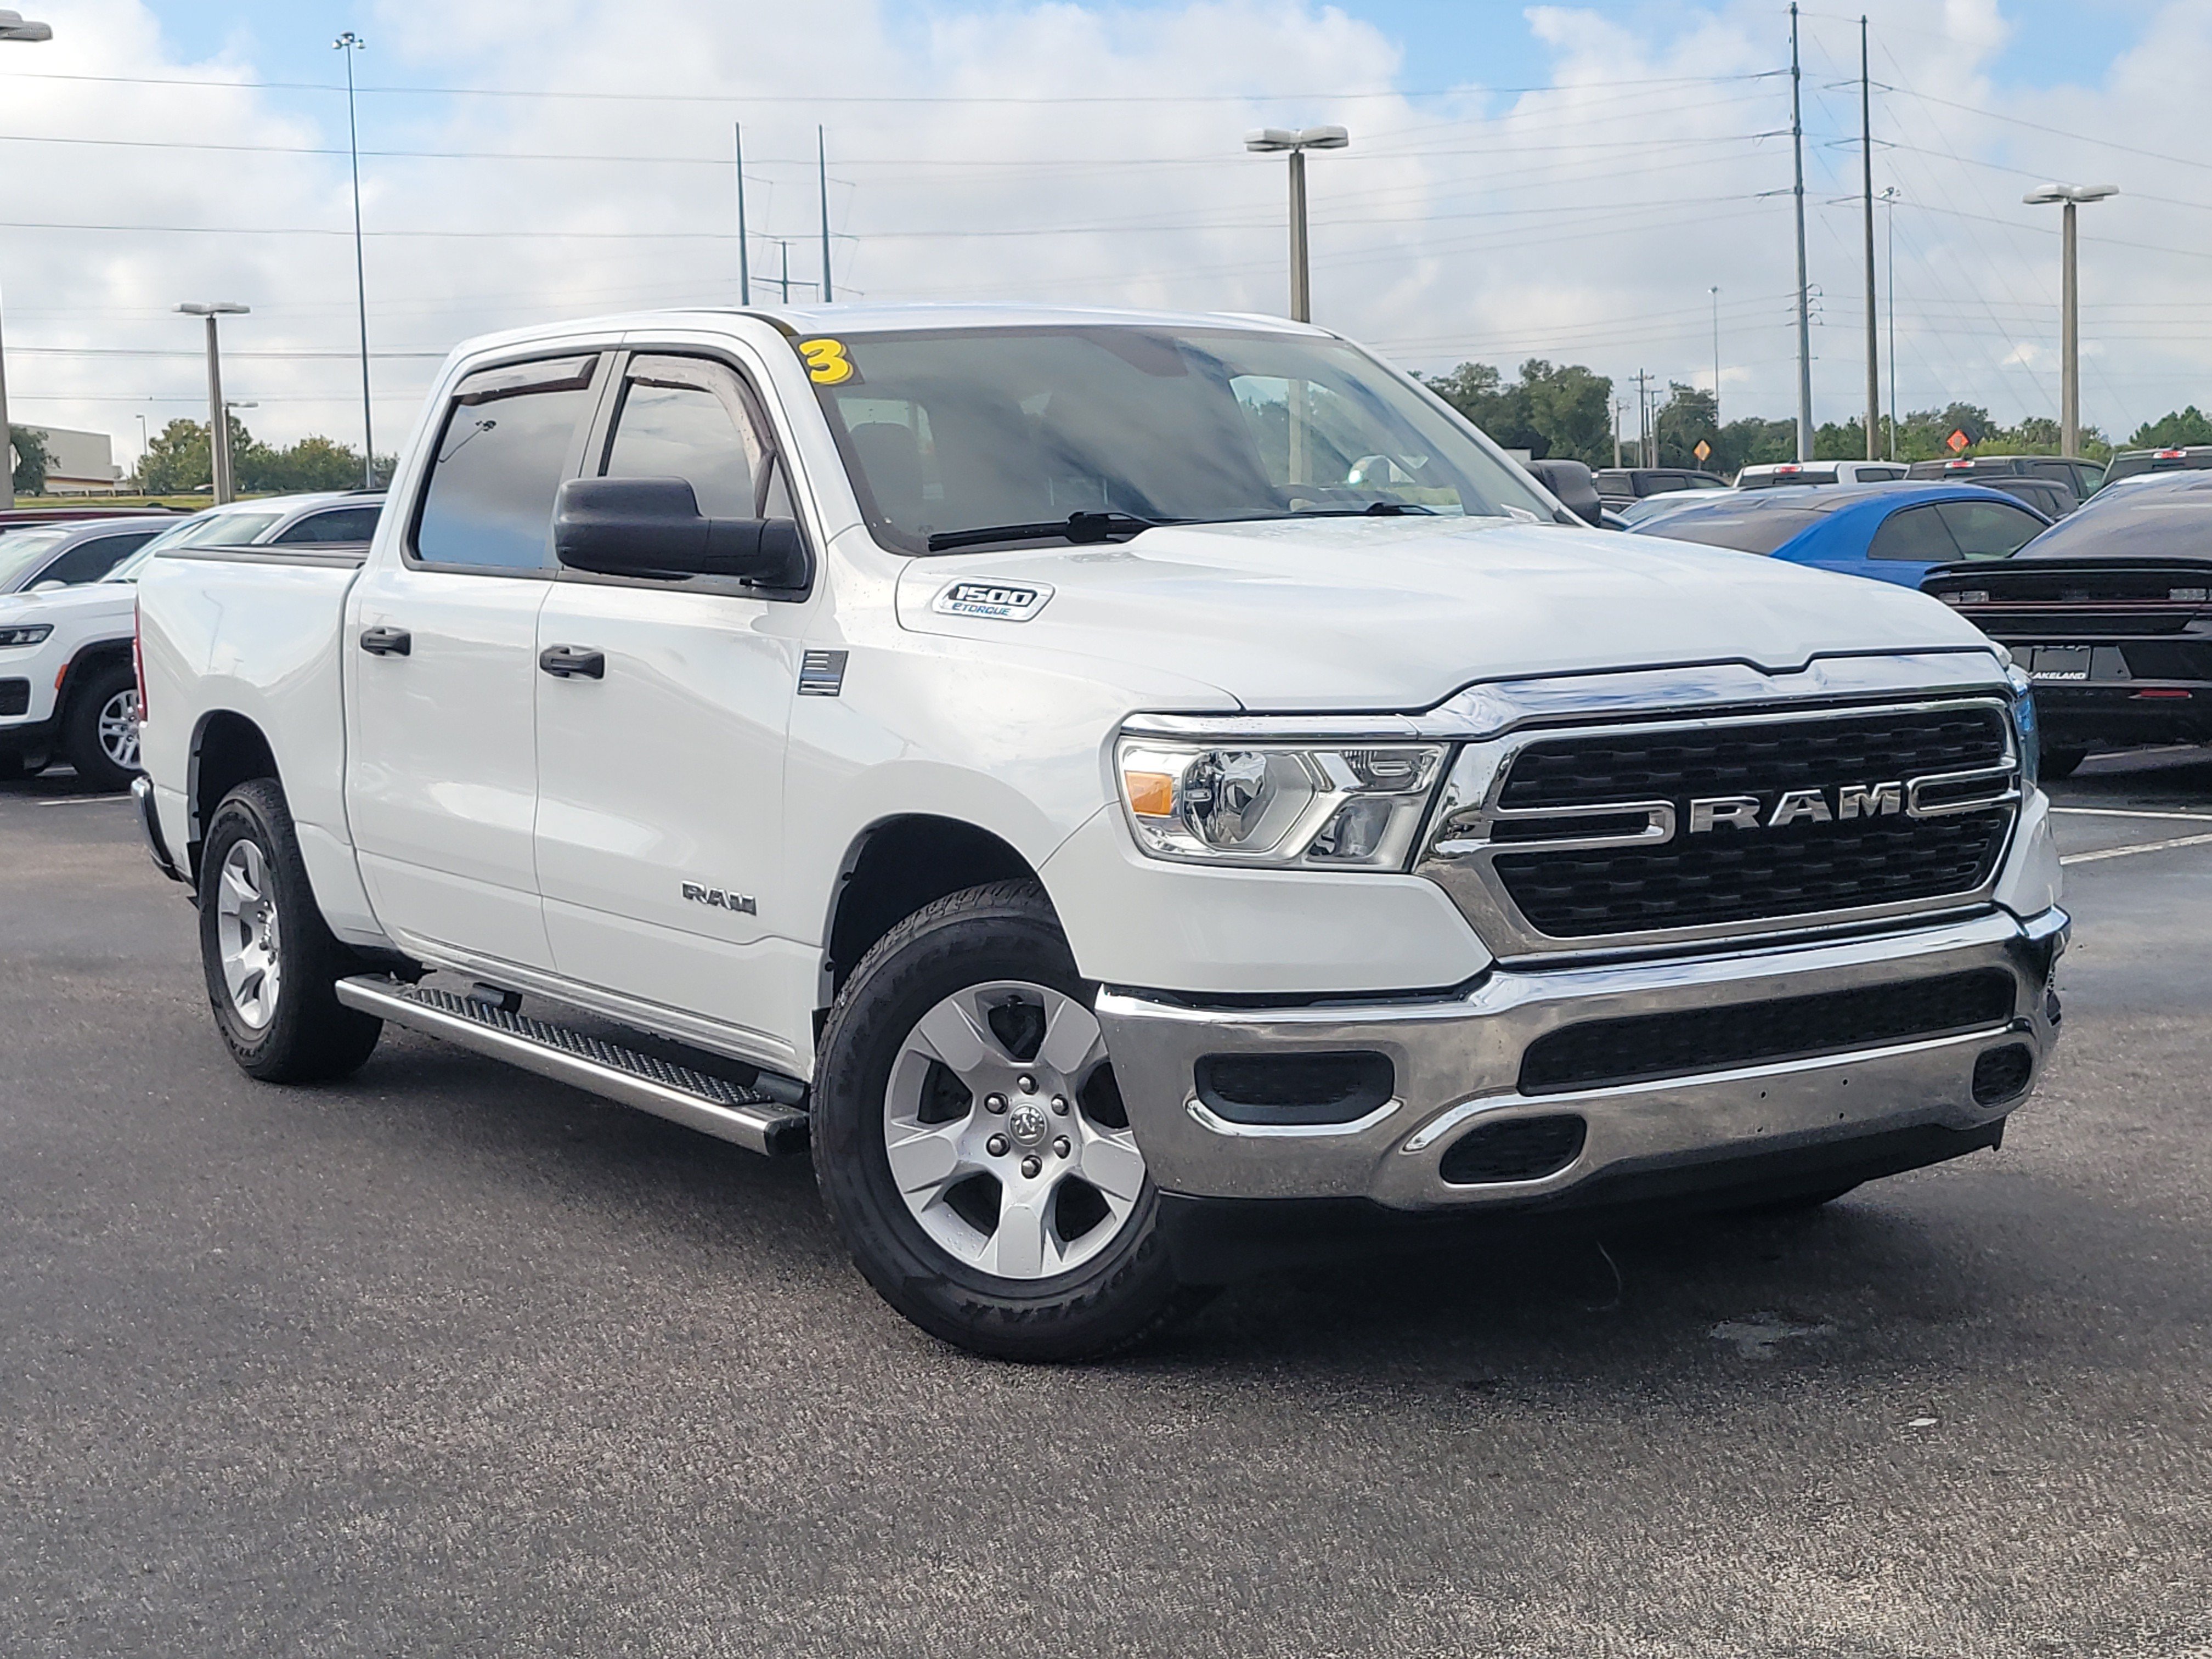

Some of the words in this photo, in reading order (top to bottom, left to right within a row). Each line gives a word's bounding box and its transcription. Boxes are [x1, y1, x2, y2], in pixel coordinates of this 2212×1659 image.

[799, 338, 854, 384] 3
[956, 586, 1034, 606] 1500
[1690, 781, 1902, 833] RAM
[681, 880, 757, 916] RAM
